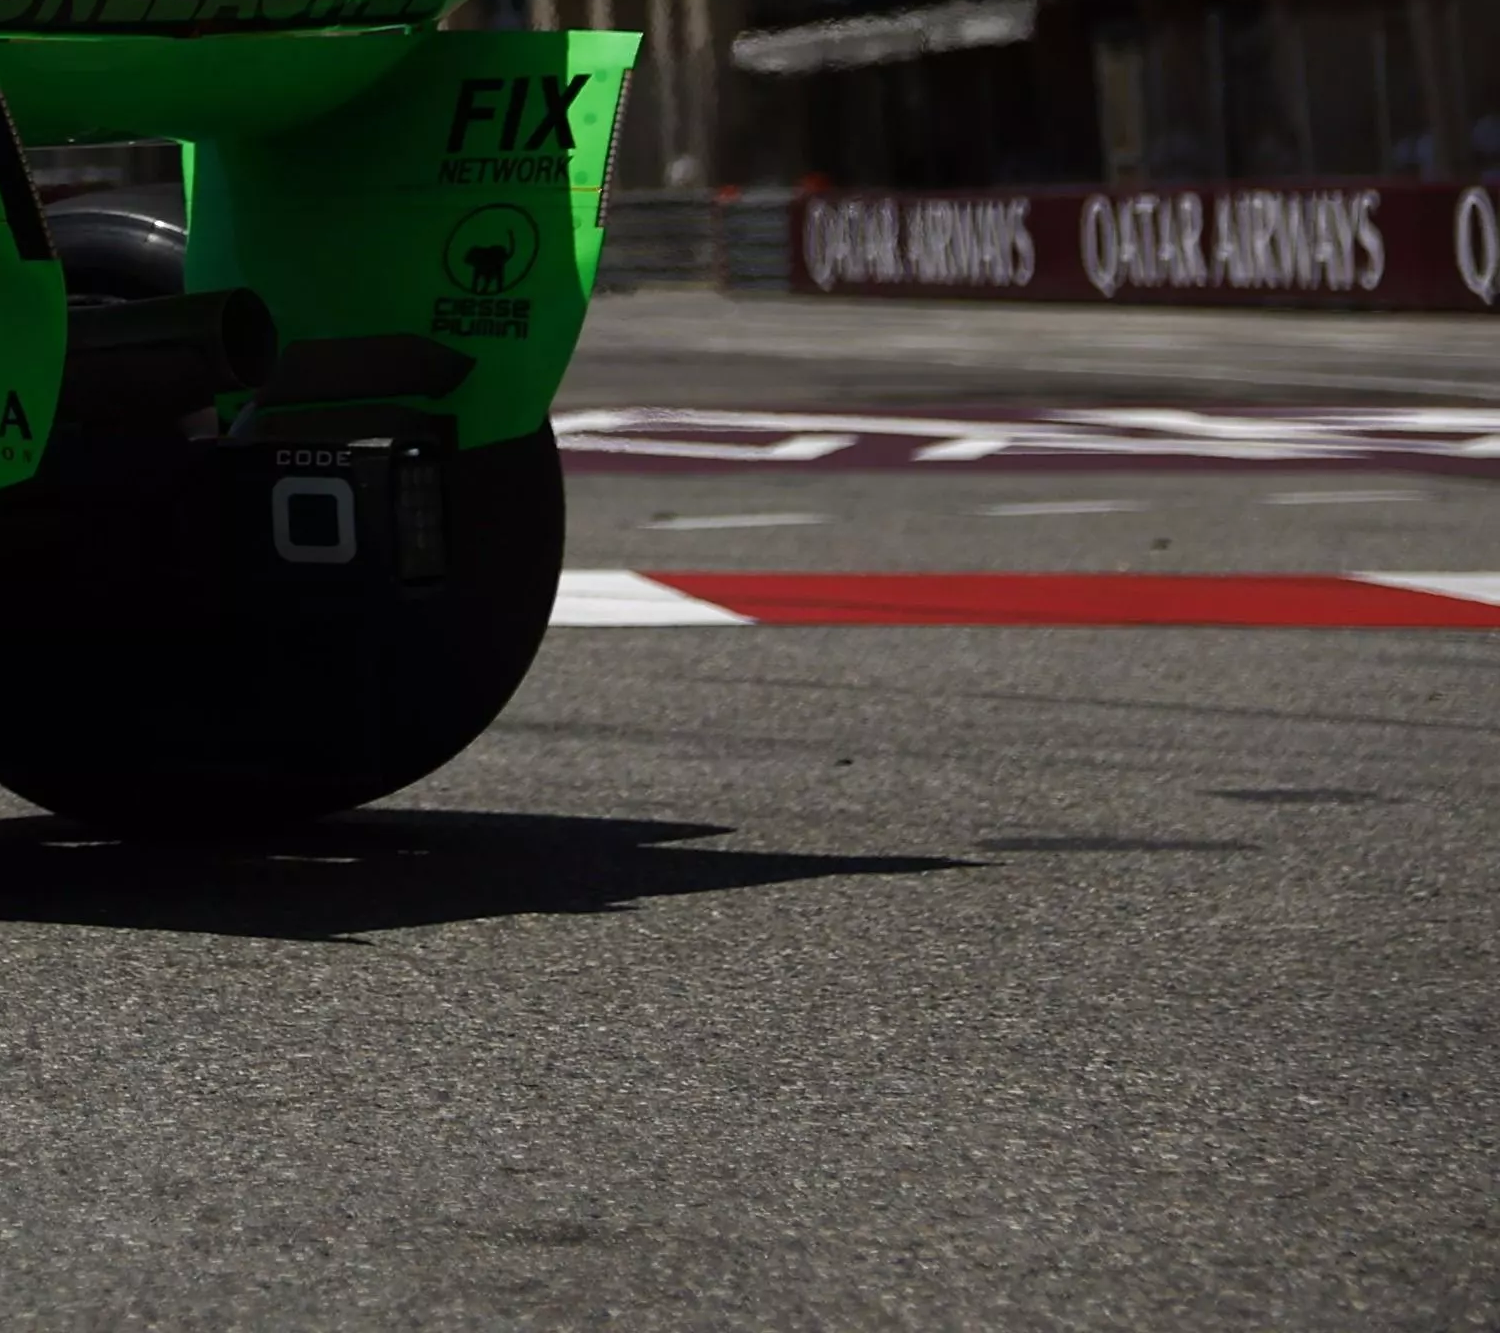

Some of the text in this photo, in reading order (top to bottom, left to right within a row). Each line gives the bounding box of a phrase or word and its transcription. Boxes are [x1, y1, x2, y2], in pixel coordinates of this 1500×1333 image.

[446, 74, 592, 153] FIX
[438, 155, 573, 185] NETWORK
[1080, 190, 1385, 299] QATAR AIRWAYS
[275, 448, 353, 467] CODE
